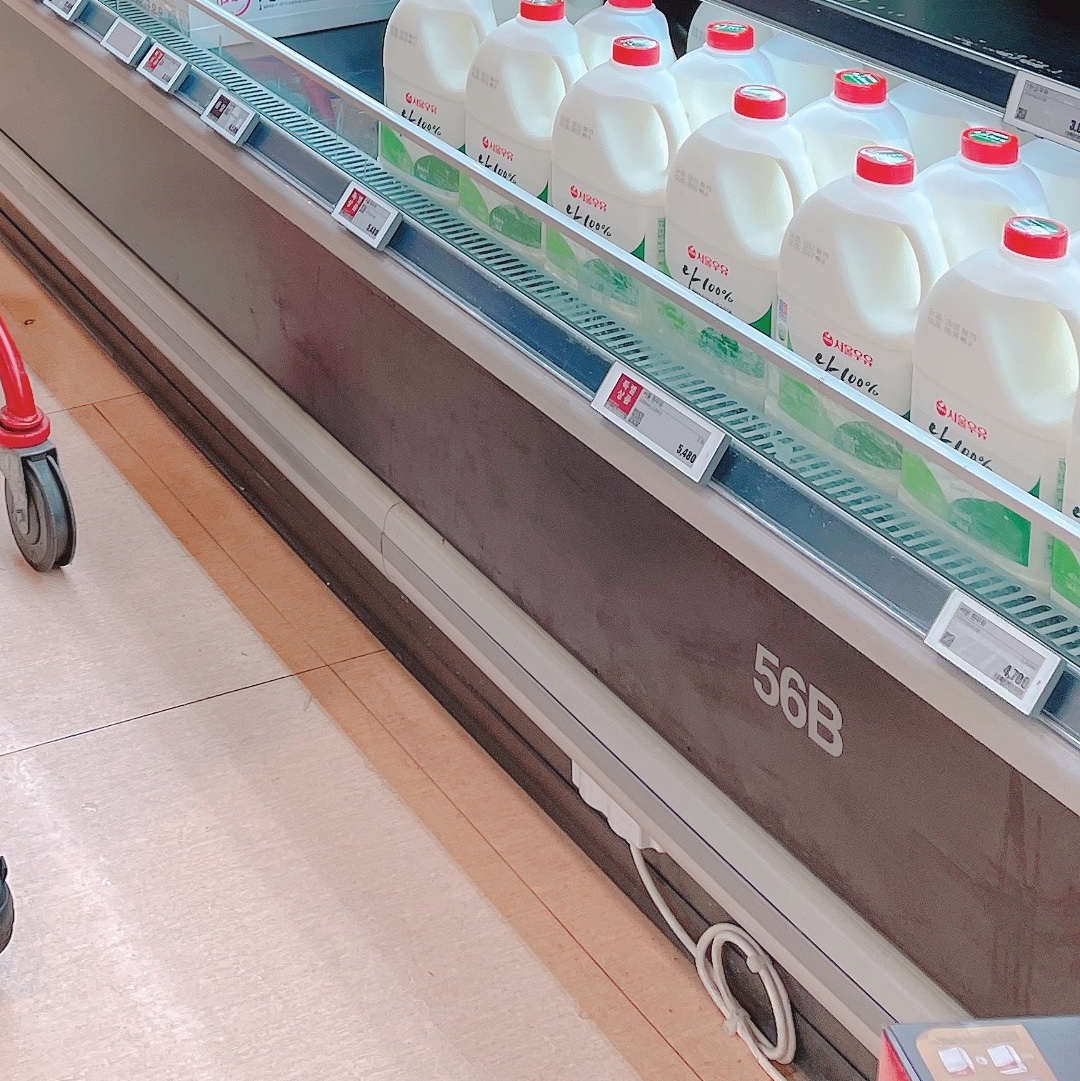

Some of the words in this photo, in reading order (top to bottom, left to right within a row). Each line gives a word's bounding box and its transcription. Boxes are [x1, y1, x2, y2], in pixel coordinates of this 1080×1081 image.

[412, 95, 438, 116] 서울우유
[489, 140, 515, 163] 서울우유
[577, 188, 608, 214] 서울우유
[695, 248, 730, 278] 서울우유
[831, 334, 875, 369] 서울우유
[946, 408, 988, 441] 서울우유
[676, 444, 697, 463] 5,480
[1003, 664, 1030, 690] 4,700
[753, 642, 844, 758] 56B
